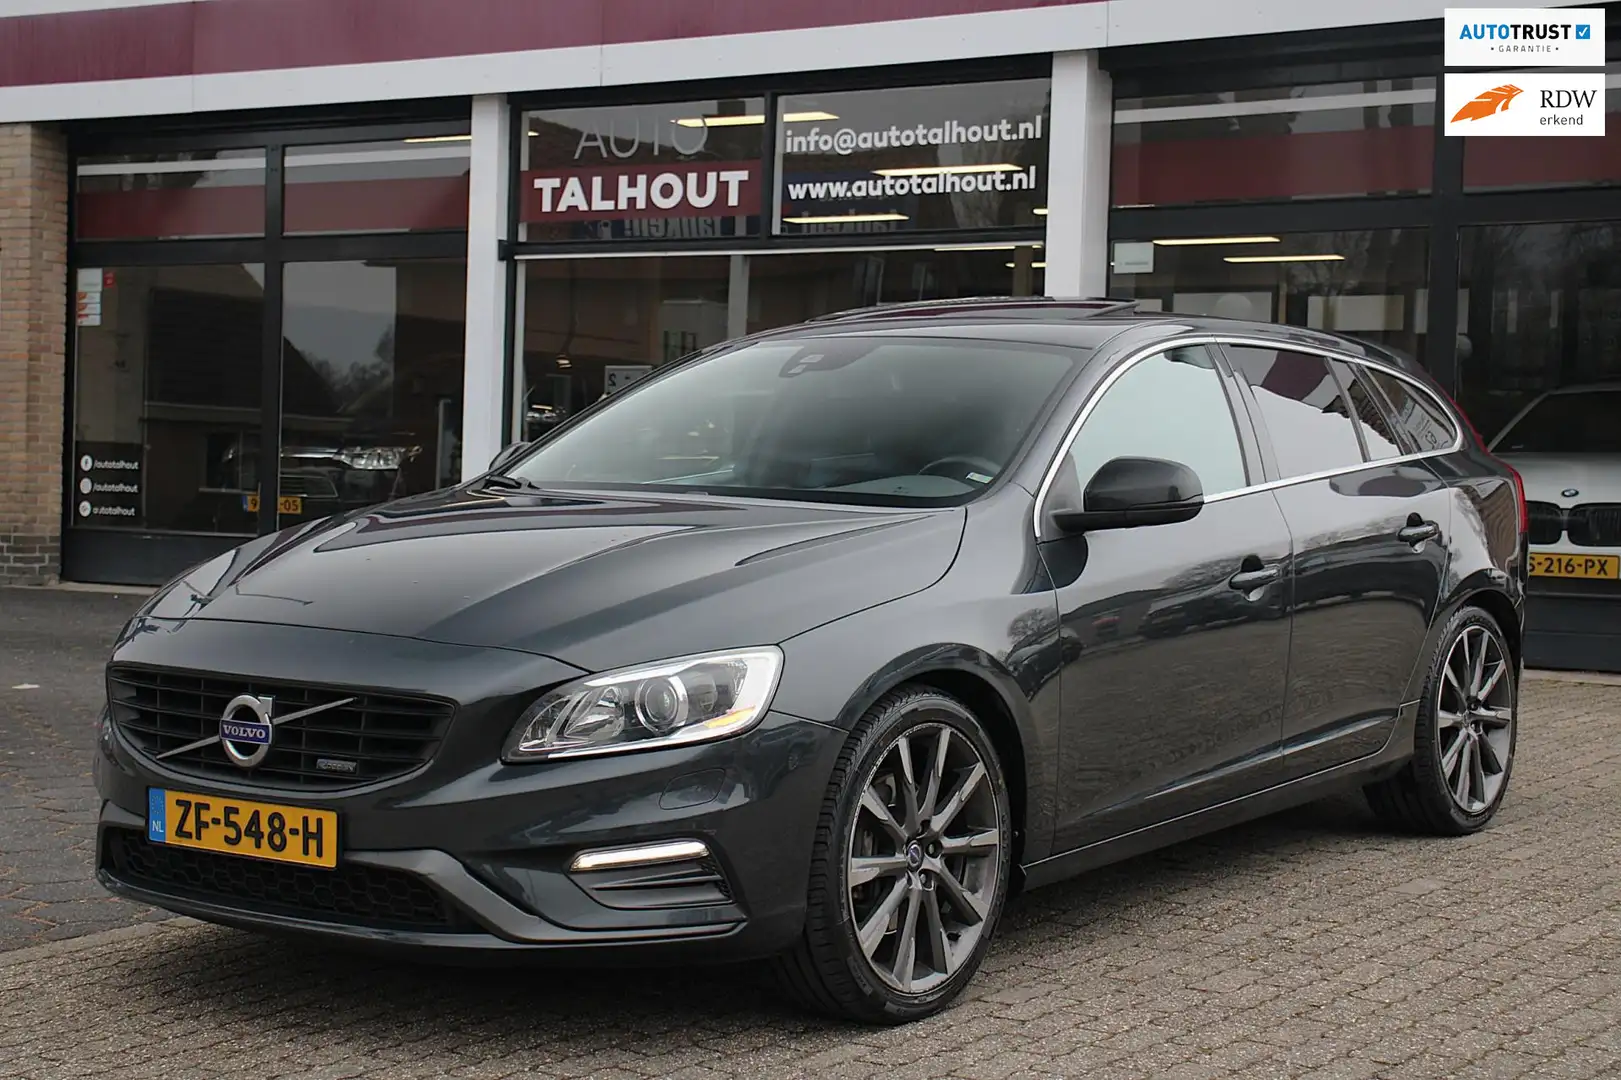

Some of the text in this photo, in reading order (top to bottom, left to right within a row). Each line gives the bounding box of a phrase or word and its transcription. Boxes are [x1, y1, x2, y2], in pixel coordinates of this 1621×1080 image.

[786, 115, 1042, 155] info@autotalhout.nl
[533, 170, 749, 213] TALHOUT
[787, 165, 1036, 200] www.autotalhout.nl
[223, 724, 266, 739] VOLVO
[152, 799, 323, 857] NL ZF-548-H
